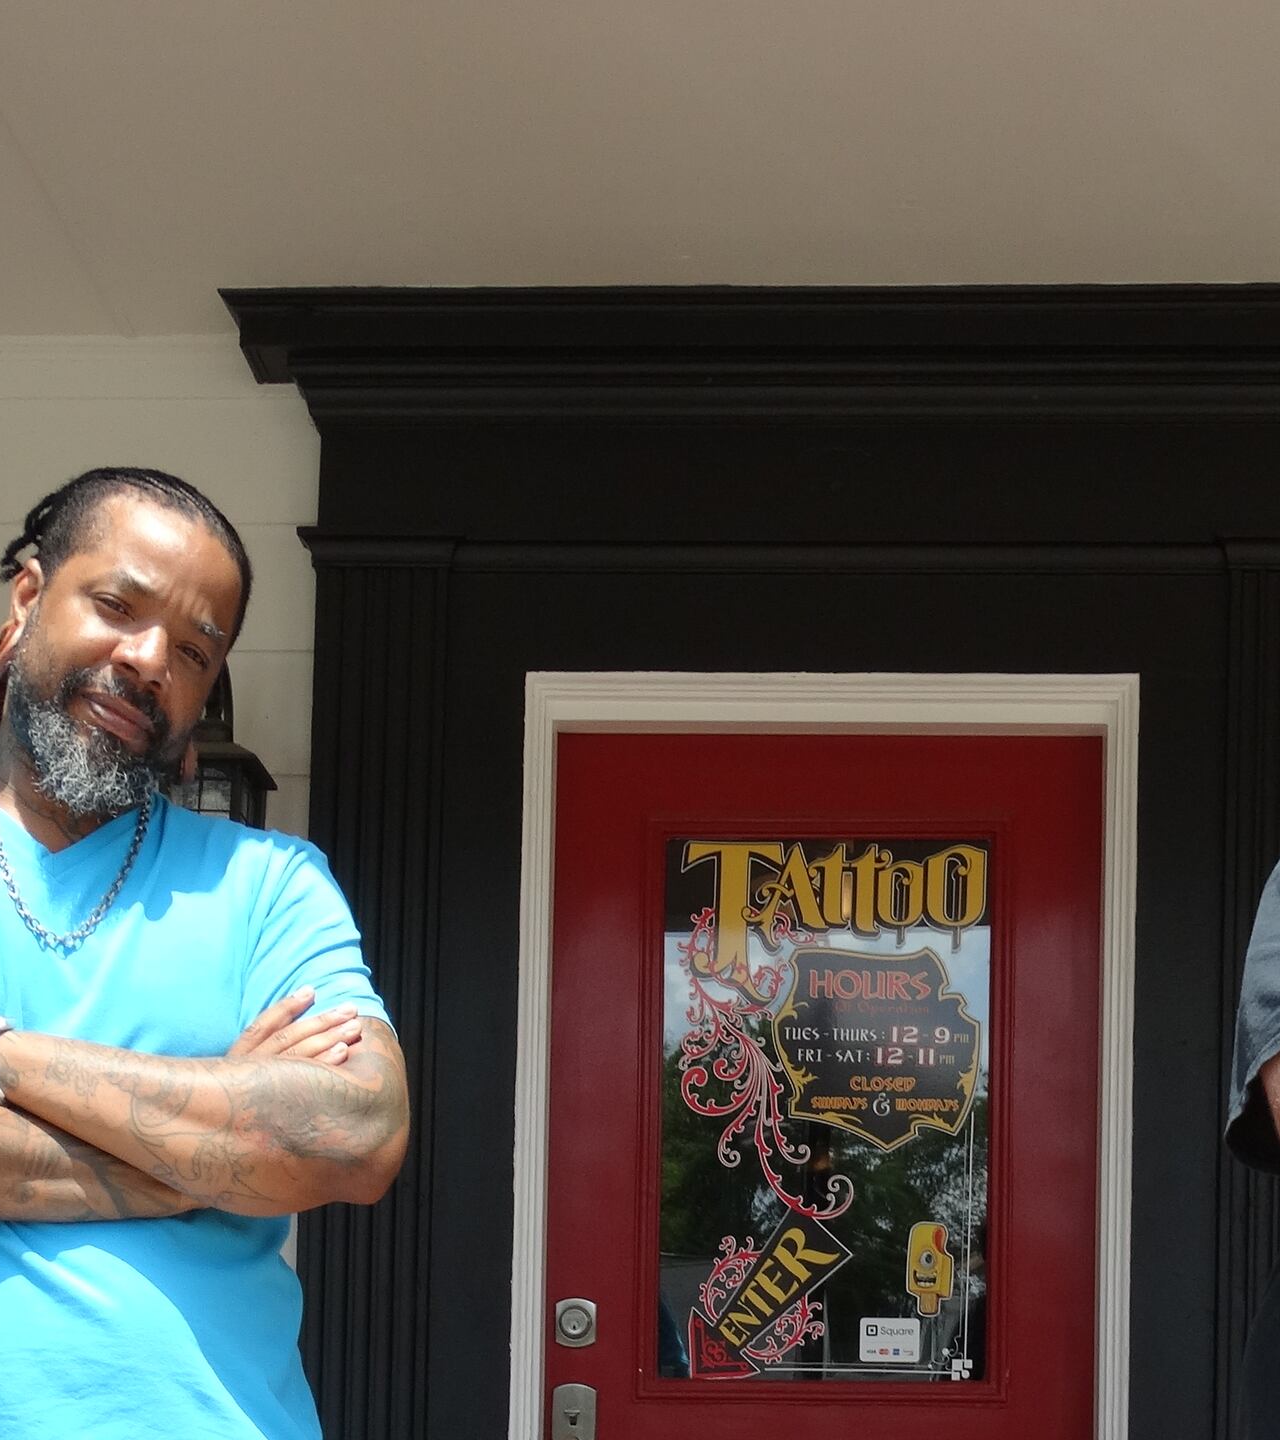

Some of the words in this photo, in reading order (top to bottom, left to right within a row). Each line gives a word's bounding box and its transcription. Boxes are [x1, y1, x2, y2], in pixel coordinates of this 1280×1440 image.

[809, 969, 932, 1000] HOURS
[849, 1076, 917, 1092] CLOSED
[811, 1097, 869, 1111] SUNDAYS
[872, 1093, 891, 1117] &
[895, 1098, 960, 1112] MONDAYS
[719, 1227, 840, 1347] ENTER
[880, 1327, 914, 1336] Square
